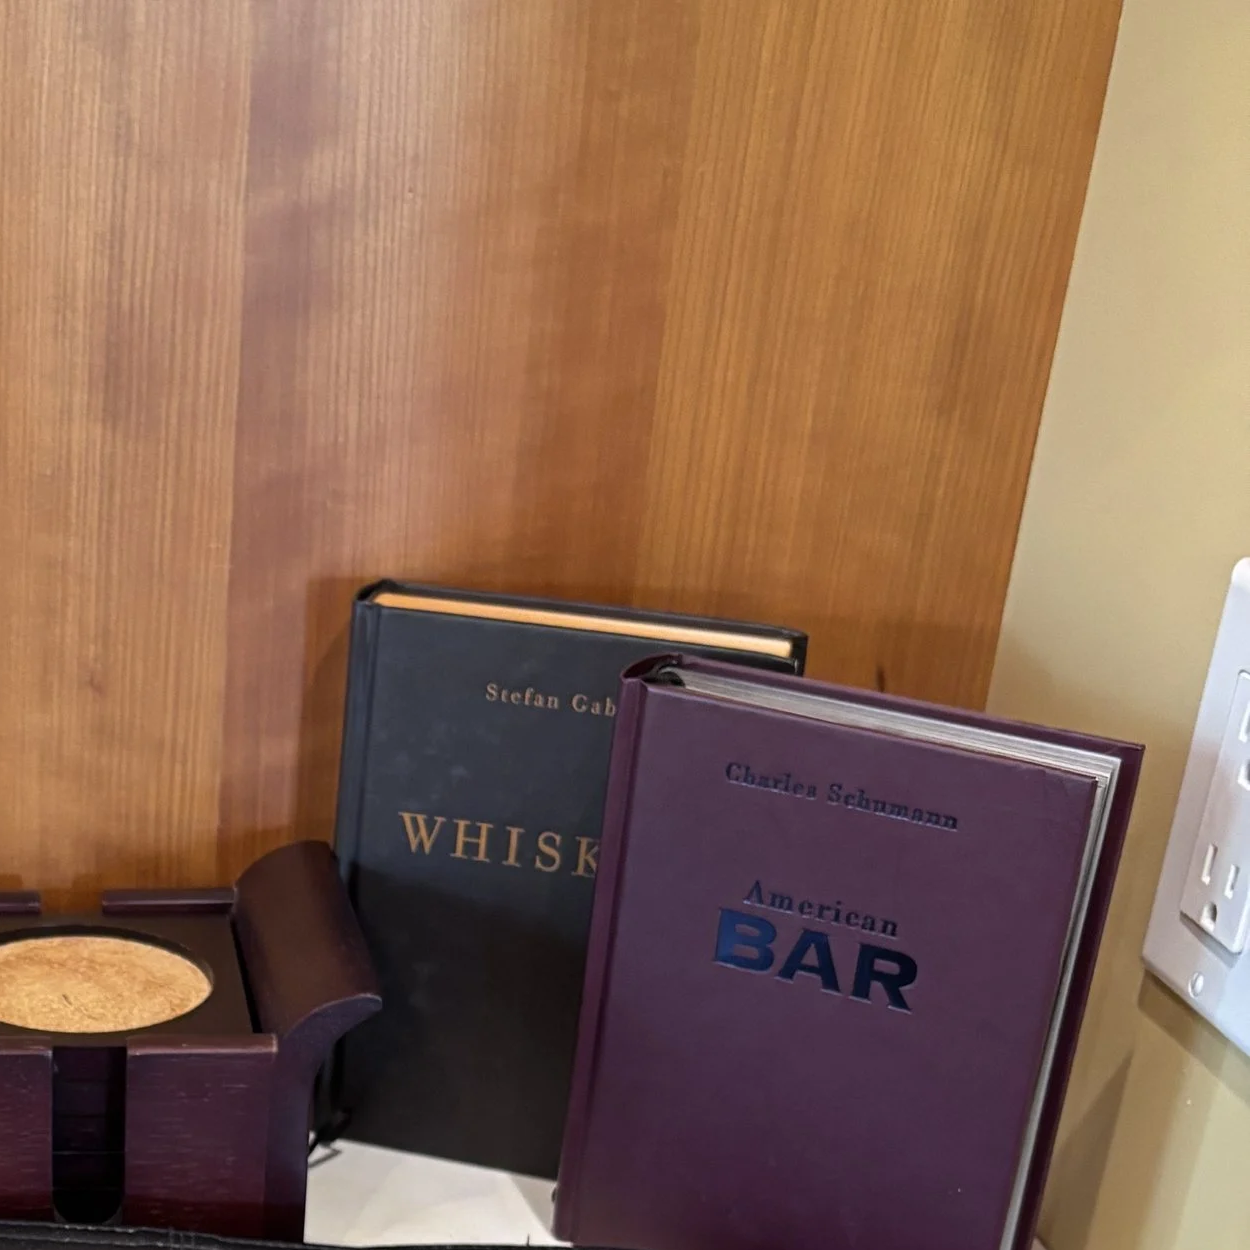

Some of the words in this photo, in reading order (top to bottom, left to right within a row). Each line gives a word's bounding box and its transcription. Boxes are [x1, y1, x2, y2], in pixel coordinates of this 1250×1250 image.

[485, 683, 559, 710] Stefan
[725, 761, 817, 800] Charles
[827, 782, 958, 831] Schumann
[743, 879, 899, 938] American
[714, 907, 918, 1013] BAR
